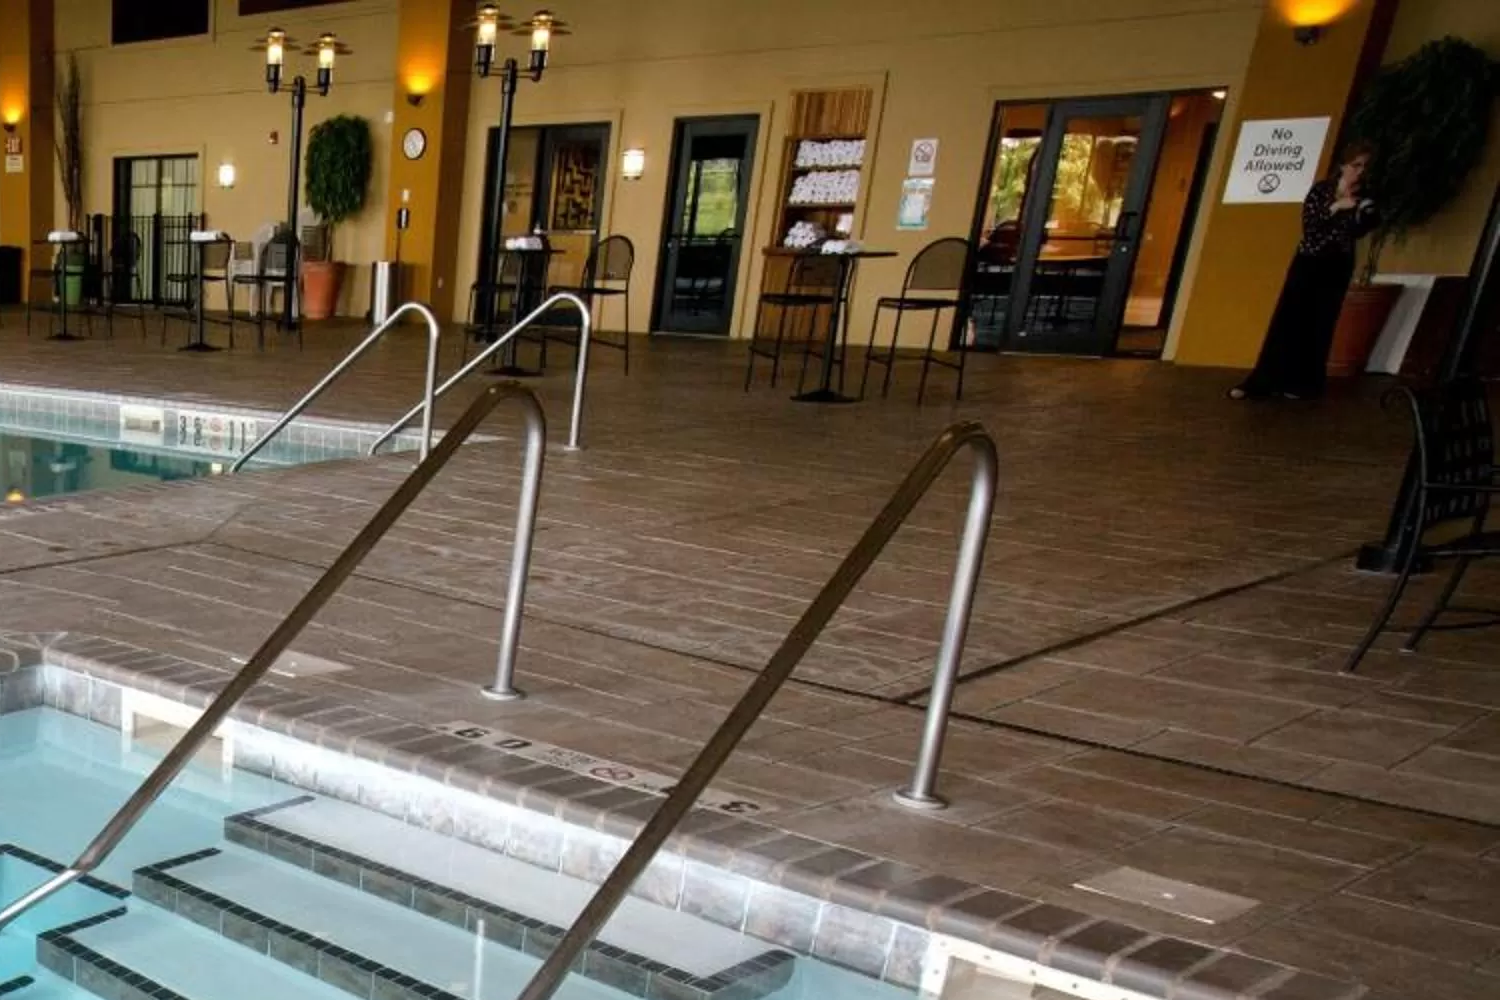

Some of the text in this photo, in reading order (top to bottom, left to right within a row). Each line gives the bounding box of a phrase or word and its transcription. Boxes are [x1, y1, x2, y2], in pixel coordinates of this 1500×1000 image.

[1271, 127, 1293, 141] No
[1253, 143, 1303, 158] Diving
[1243, 158, 1305, 172] Allowed
